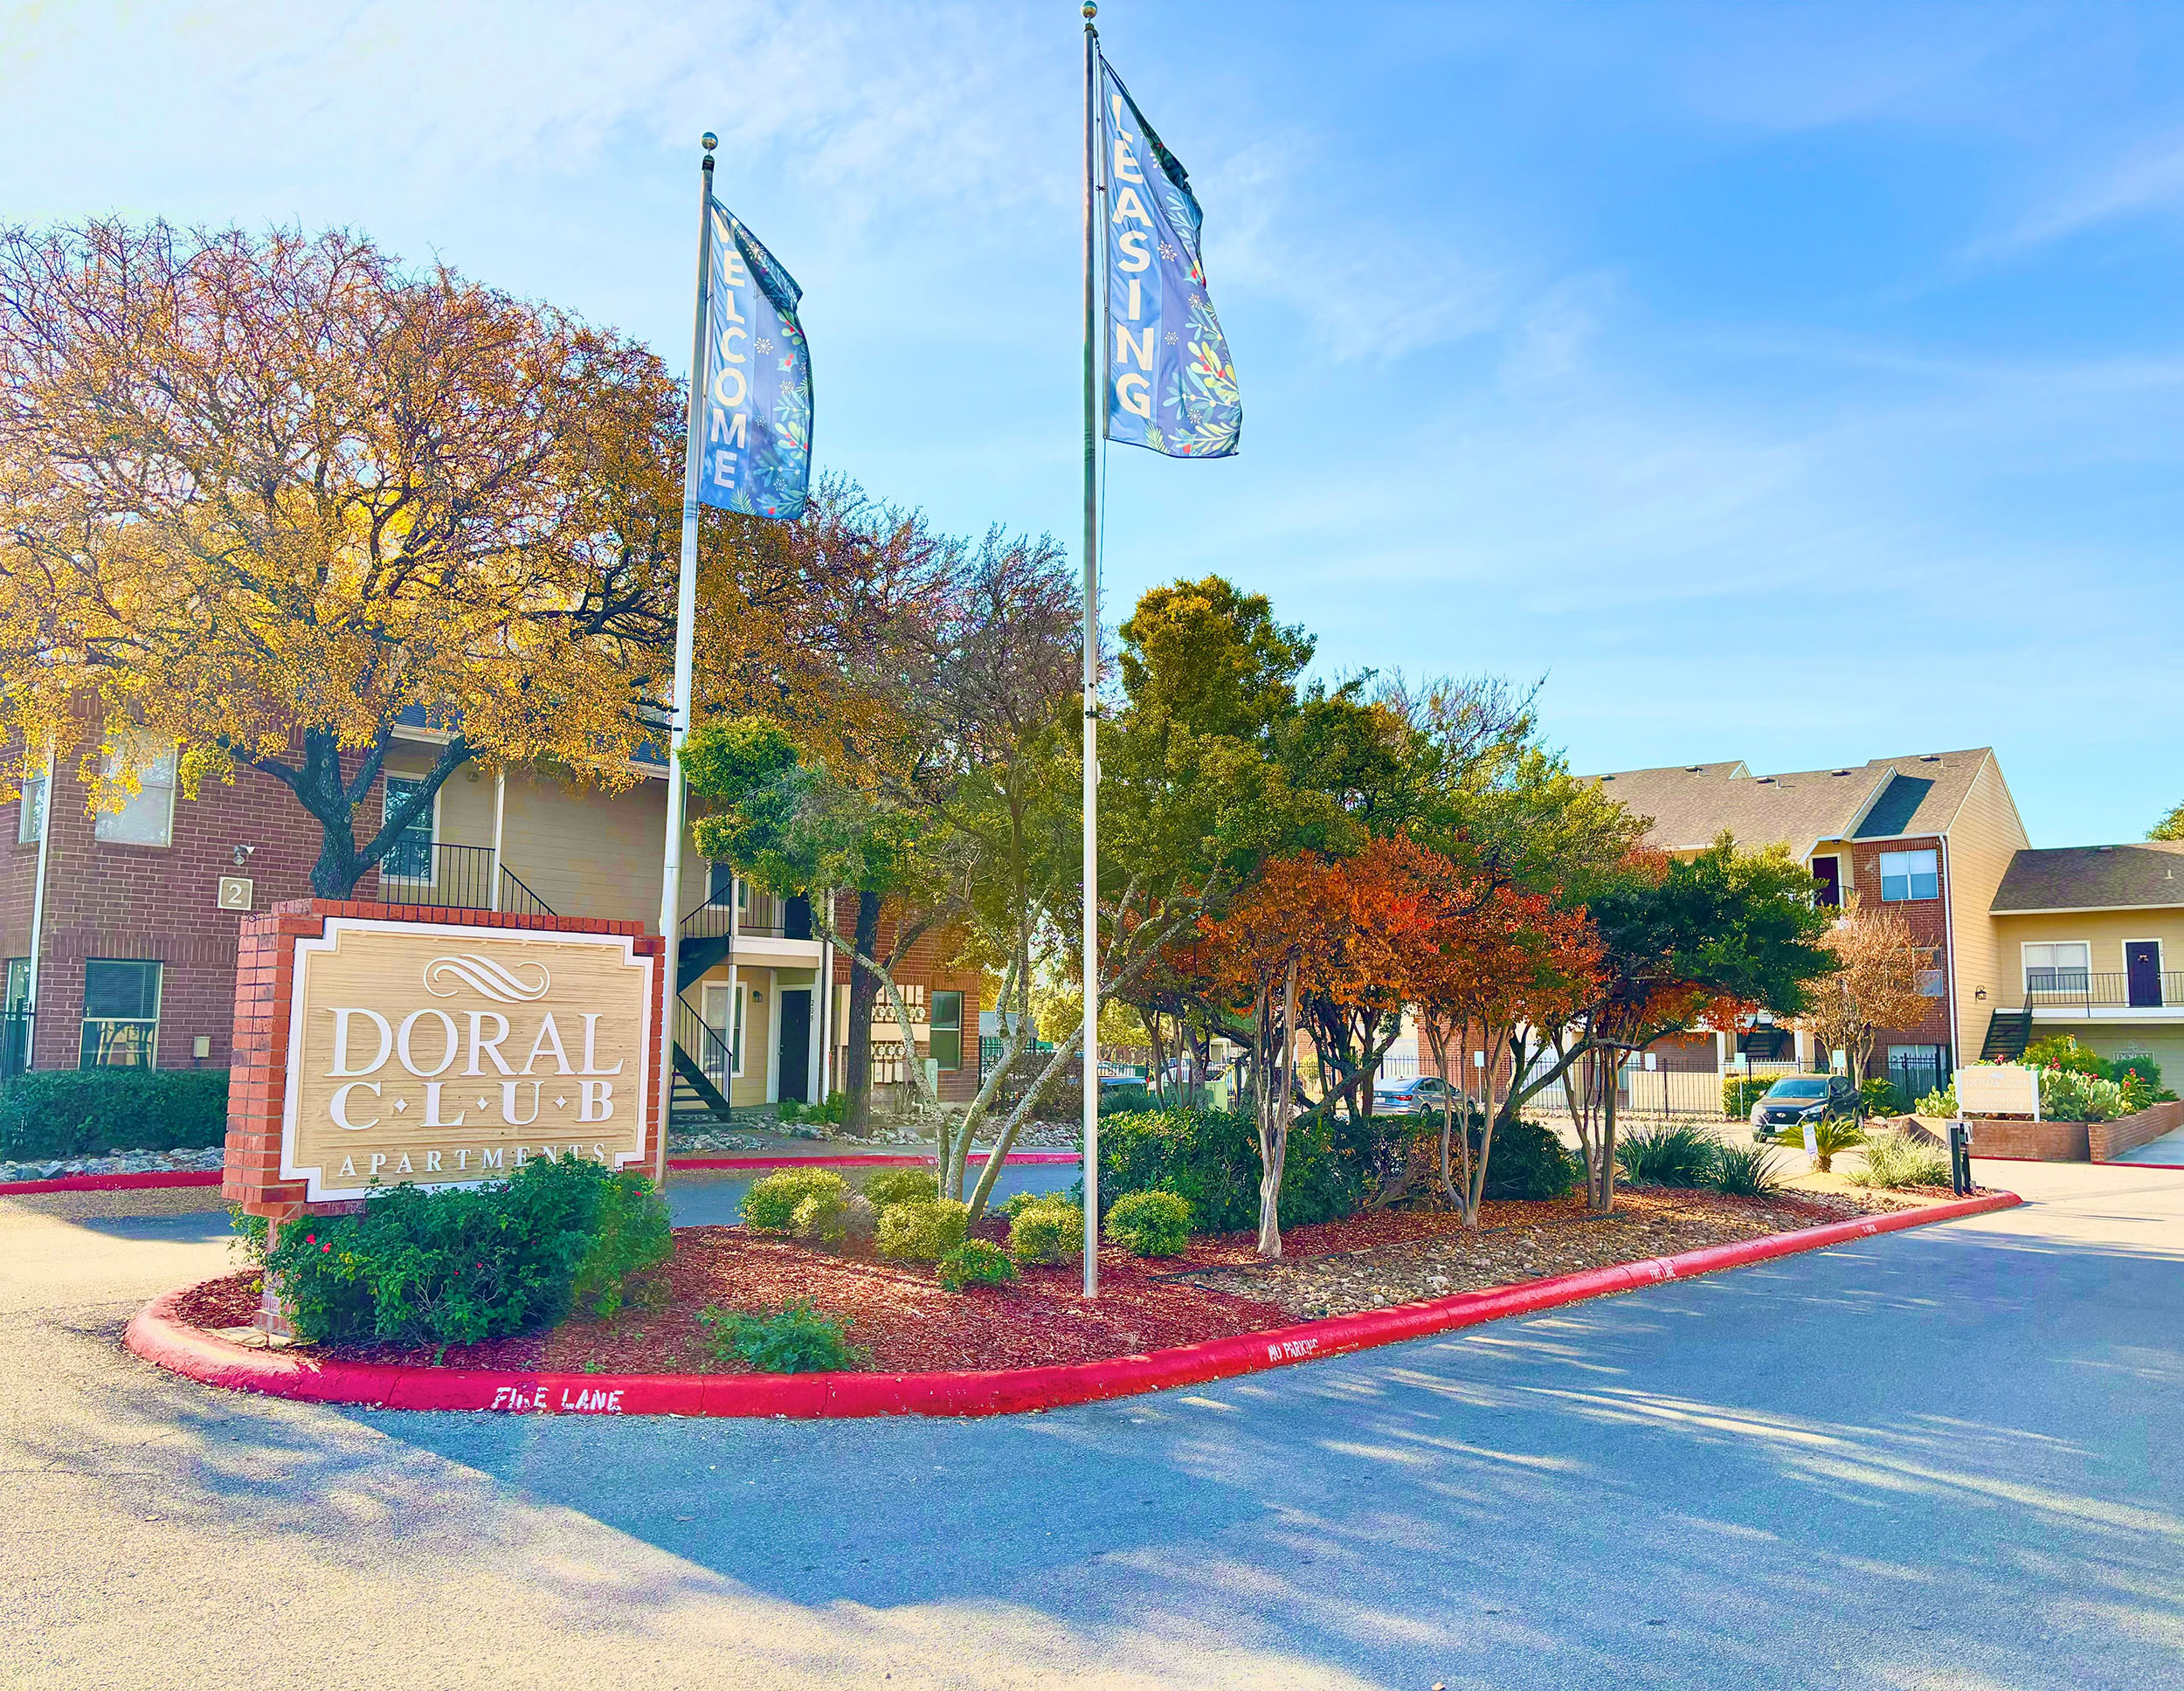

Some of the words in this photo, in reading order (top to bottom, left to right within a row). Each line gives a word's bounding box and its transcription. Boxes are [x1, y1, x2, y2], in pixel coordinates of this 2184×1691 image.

[1111, 93, 1155, 419] LEASING
[227, 883, 243, 905] 2
[324, 1007, 624, 1077] DORAL
[338, 1142, 605, 1177] APARTMENTS
[561, 1387, 625, 1411] LANE
